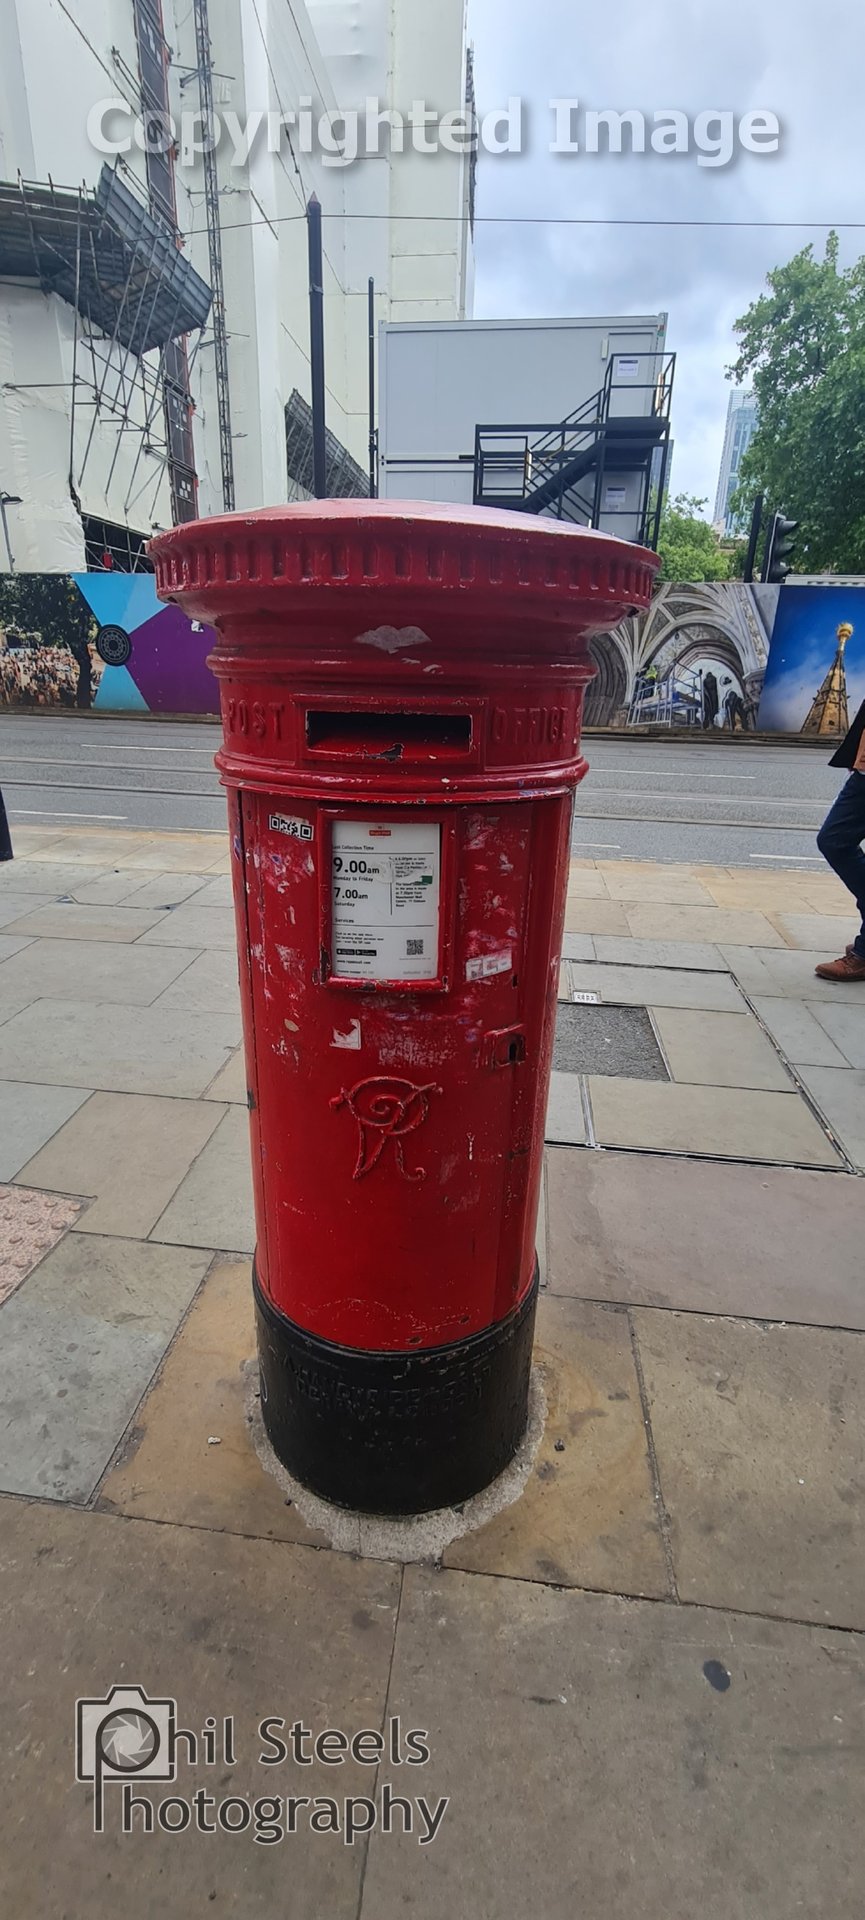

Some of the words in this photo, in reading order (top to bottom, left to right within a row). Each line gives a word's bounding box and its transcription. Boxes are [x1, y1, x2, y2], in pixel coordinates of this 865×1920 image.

[226, 697, 285, 741] POST
[333, 856, 380, 874] 9.00am
[333, 886, 369, 900] 7.00am
